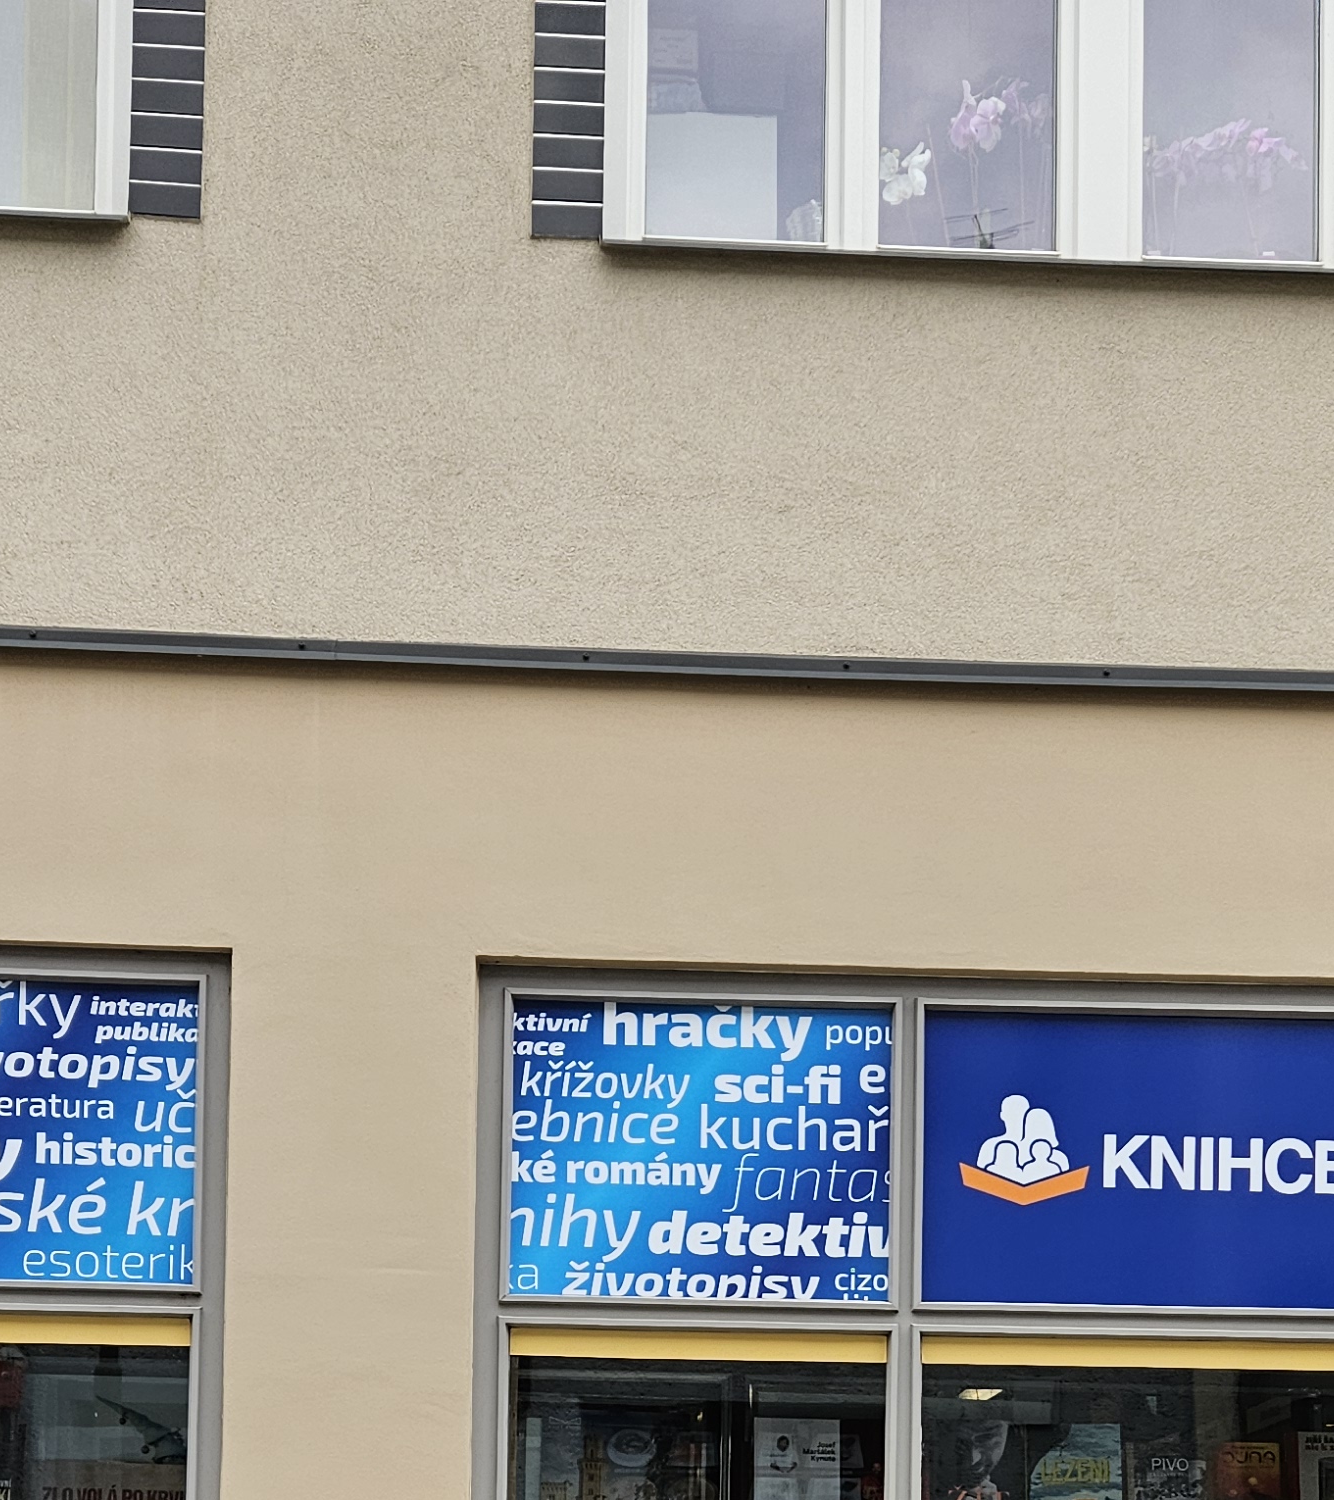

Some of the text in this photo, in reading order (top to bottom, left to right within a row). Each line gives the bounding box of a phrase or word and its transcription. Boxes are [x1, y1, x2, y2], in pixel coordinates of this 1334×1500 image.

[603, 1002, 813, 1062] hračky
[520, 1060, 691, 1108] křížovky
[714, 1064, 842, 1105] sci-fi
[511, 1098, 890, 1152] ebnice kuchař
[35, 1132, 196, 1169] historic
[566, 1152, 723, 1195] romány
[834, 1268, 889, 1292] cizo
[1151, 1458, 1190, 1471] PIVO
